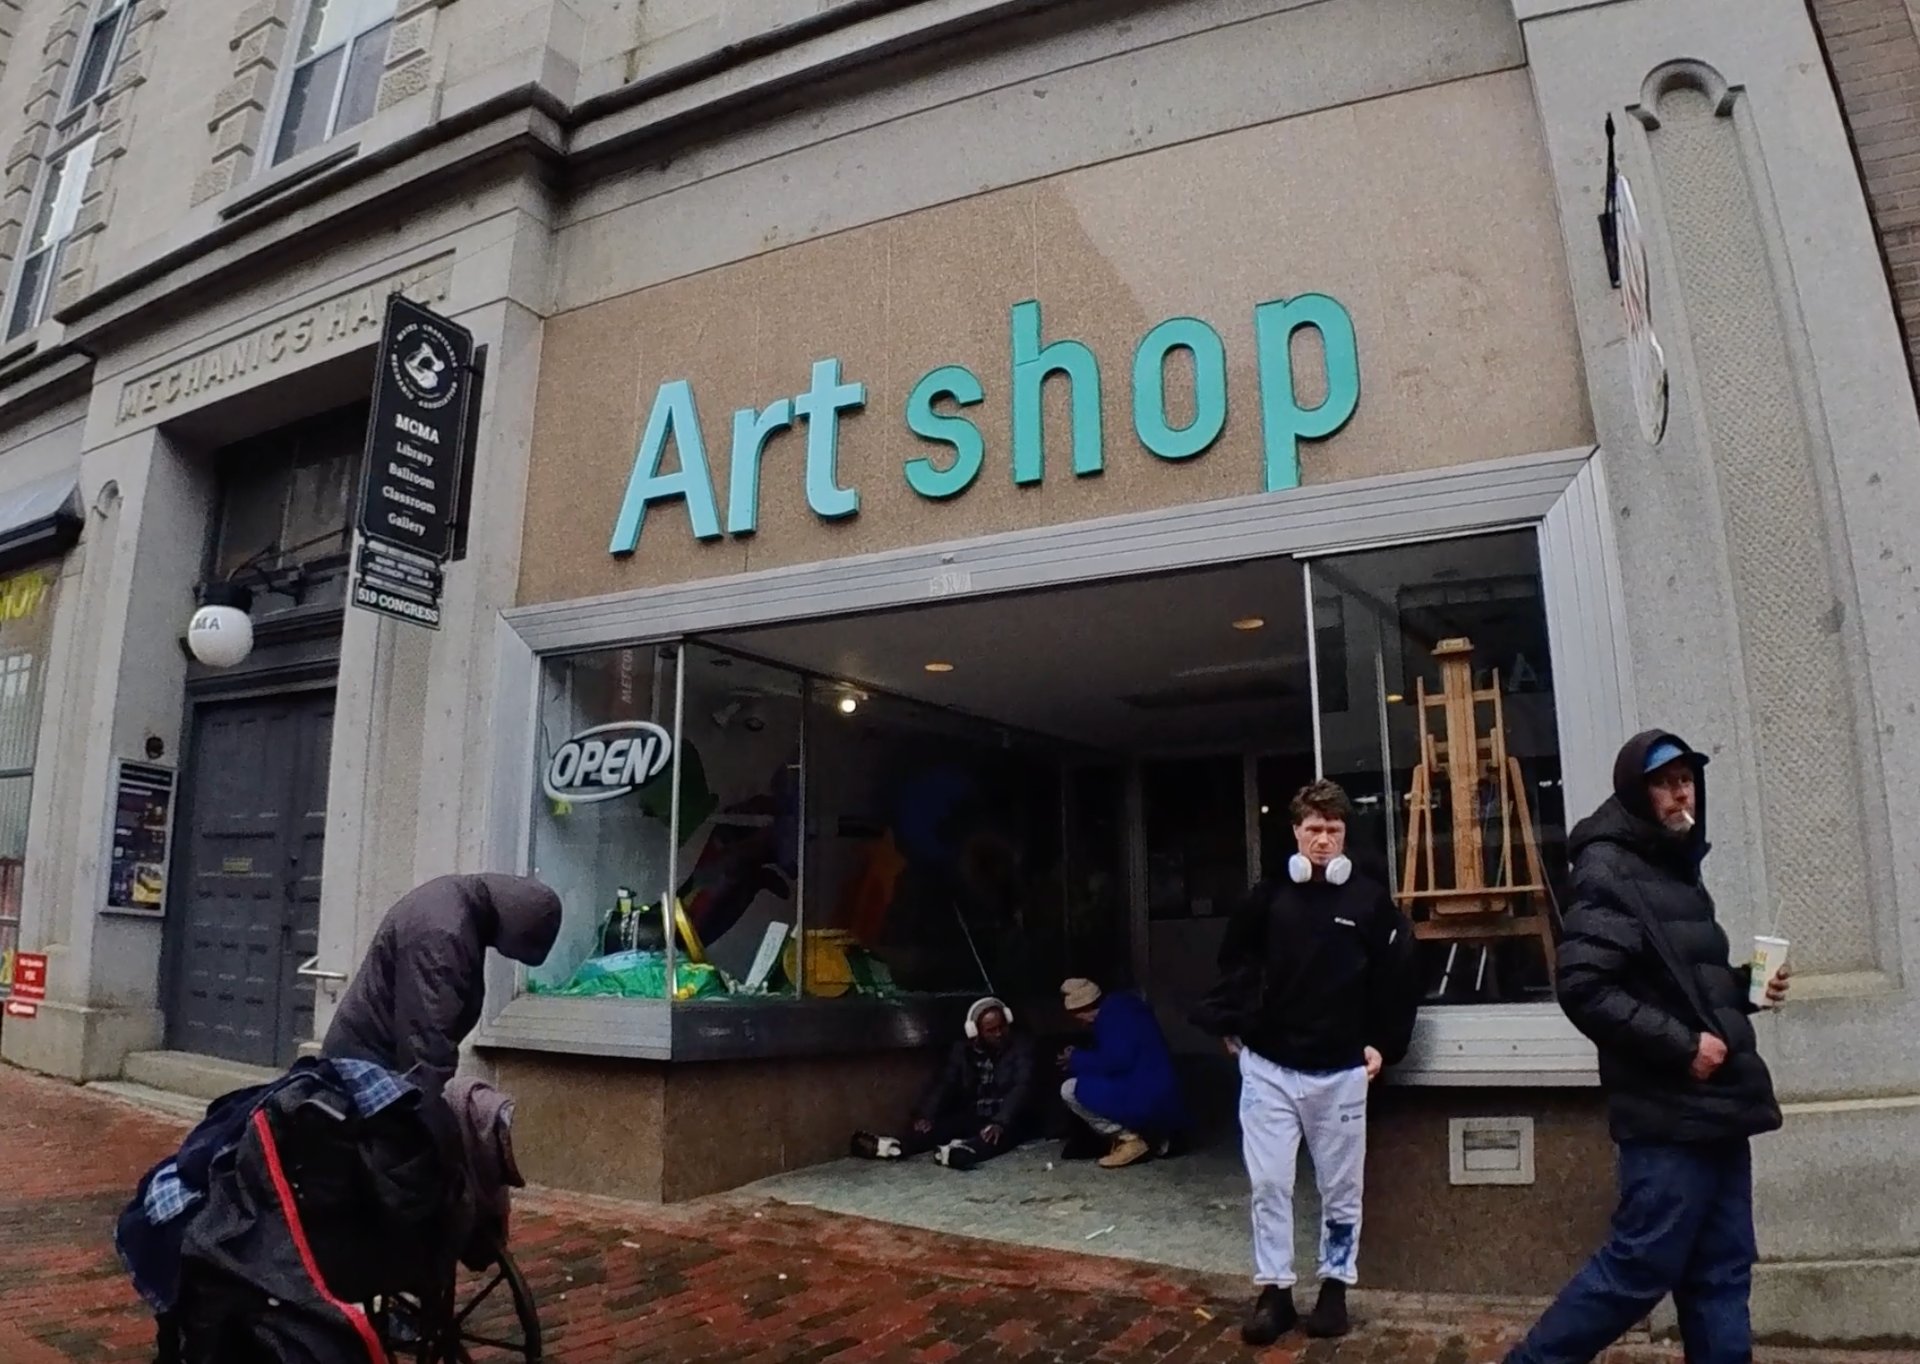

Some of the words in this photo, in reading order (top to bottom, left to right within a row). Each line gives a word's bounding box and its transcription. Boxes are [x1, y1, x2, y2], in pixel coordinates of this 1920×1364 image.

[395, 413, 440, 444] MCMA
[609, 358, 866, 556] Art
[904, 293, 1362, 497] shop
[396, 441, 434, 467] Library
[388, 462, 435, 490] Ballroom
[382, 485, 436, 514] Classroom
[388, 512, 426, 536] Gallery
[358, 587, 377, 604] 519
[378, 594, 439, 622] CONGRESS
[550, 736, 658, 789] OPEN
